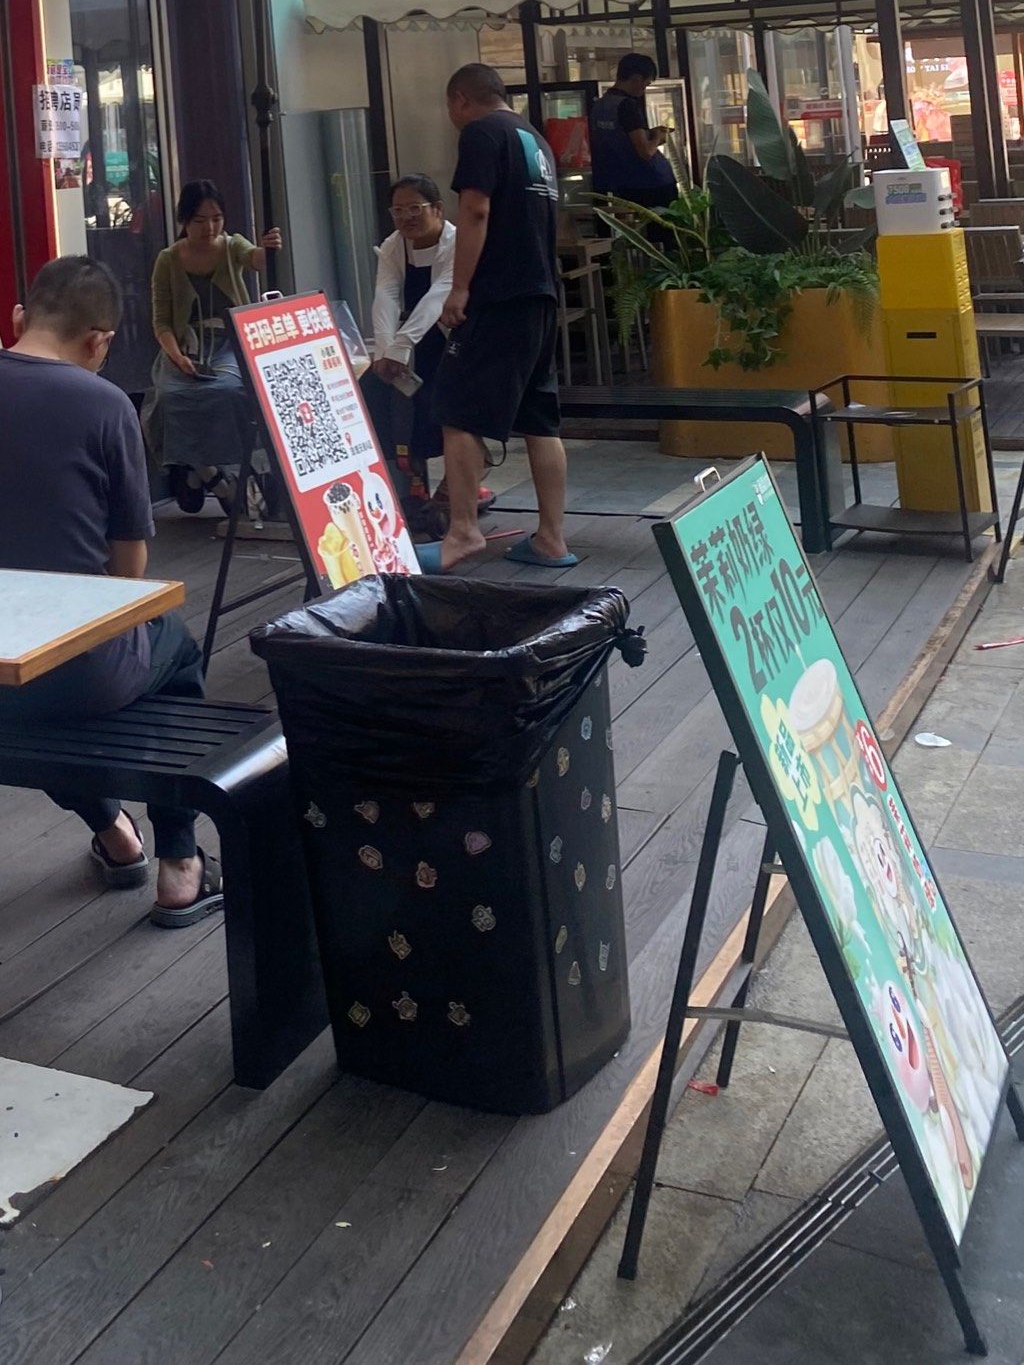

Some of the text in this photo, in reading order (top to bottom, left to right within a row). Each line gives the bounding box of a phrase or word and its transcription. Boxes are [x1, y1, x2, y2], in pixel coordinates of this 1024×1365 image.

[243, 304, 334, 350] 扫码点单 更快哦
[689, 501, 775, 625] 茉莉奶绿
[729, 557, 826, 695] 2杯仅10元
